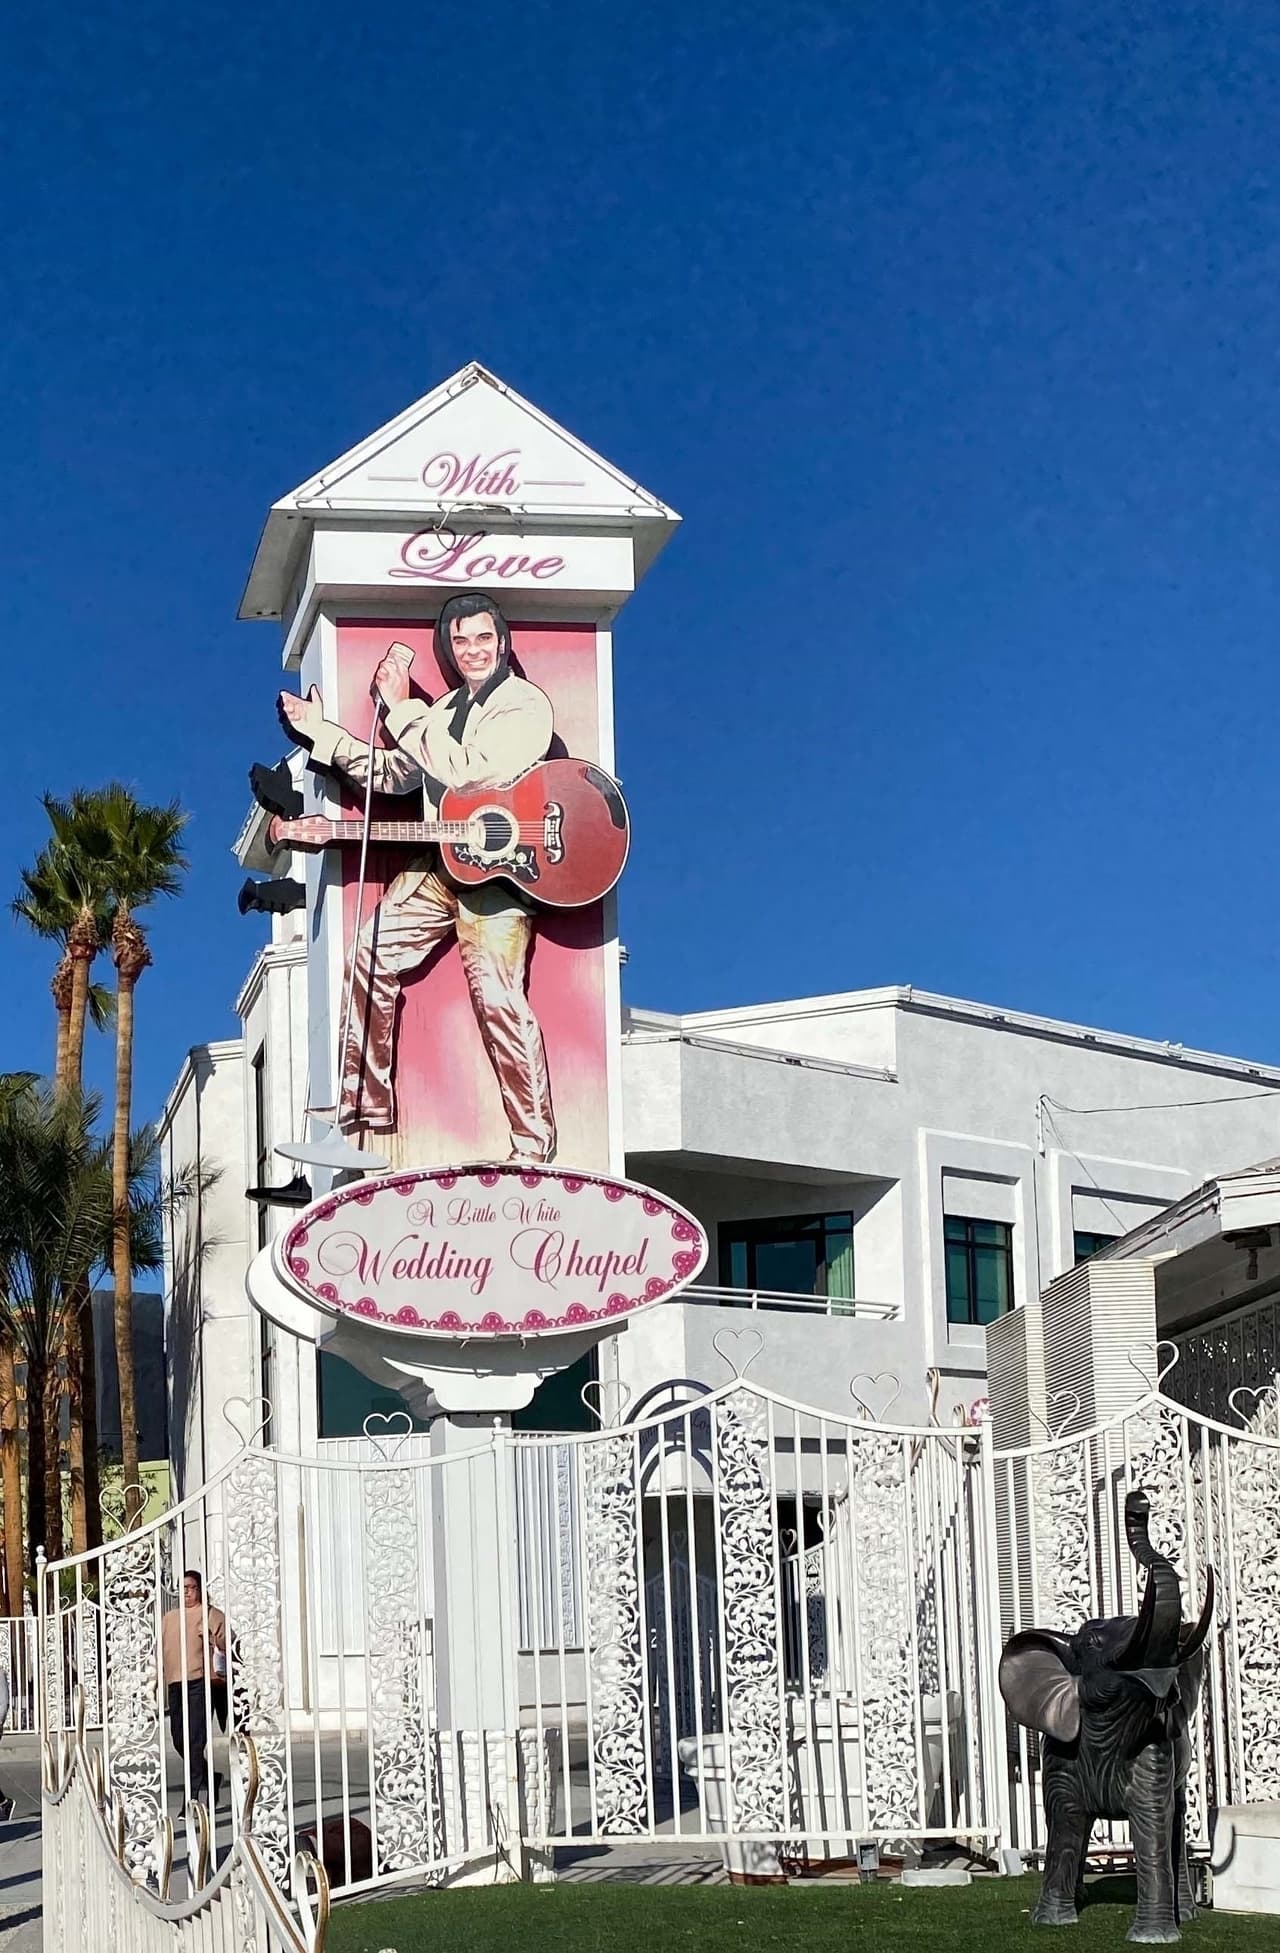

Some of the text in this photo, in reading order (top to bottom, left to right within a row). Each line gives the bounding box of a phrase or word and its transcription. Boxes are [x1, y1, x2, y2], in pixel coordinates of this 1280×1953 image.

[422, 449, 522, 497] With
[388, 526, 566, 583] Love
[406, 1197, 561, 1227] A Little White
[317, 1227, 649, 1296] Wedding Chapel
